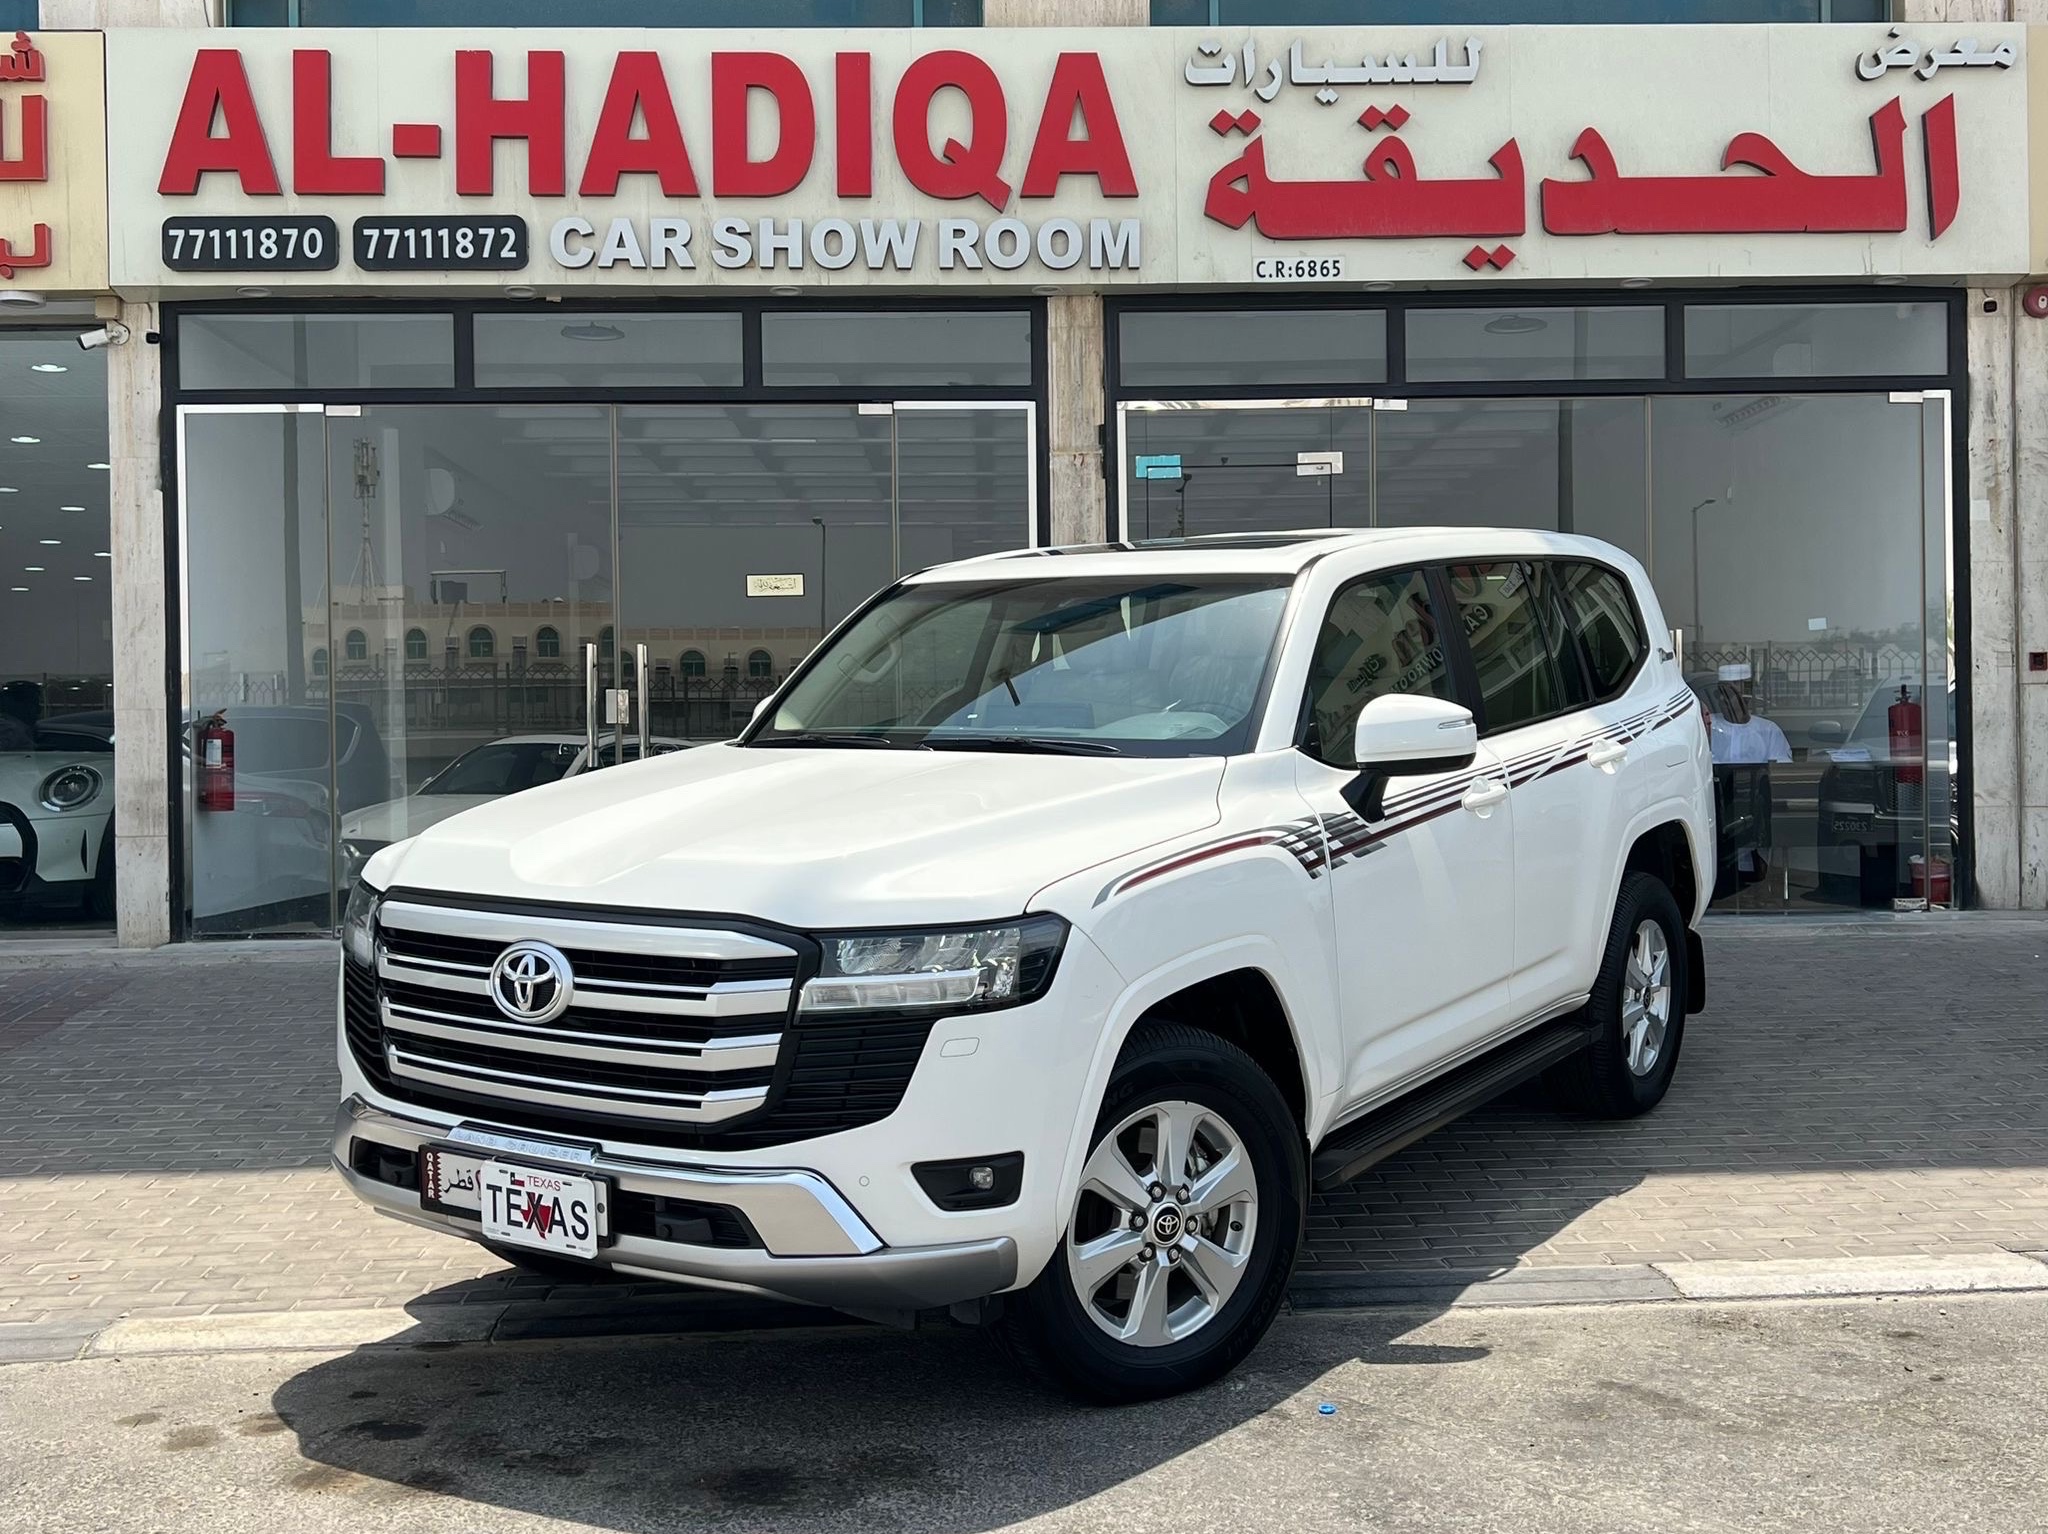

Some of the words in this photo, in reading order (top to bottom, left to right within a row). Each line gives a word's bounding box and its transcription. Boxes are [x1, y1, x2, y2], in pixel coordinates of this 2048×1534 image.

[1184, 35, 1484, 105] للسيارات
[1855, 27, 2017, 81] معرض
[158, 49, 1139, 213] AL-HADIQA
[1203, 92, 1960, 271] الحديقة
[169, 228, 323, 260] 77111870
[363, 227, 517, 260] 77111872
[550, 216, 695, 270] CAR
[712, 216, 921, 270] SHOW
[938, 218, 1140, 271] ROOM
[1256, 260, 1341, 279] C.R:6865
[426, 1152, 435, 1199] QATAR
[442, 1169, 474, 1193] قطر
[527, 1175, 561, 1191] TEXAS
[486, 1183, 589, 1241] TEXAS
